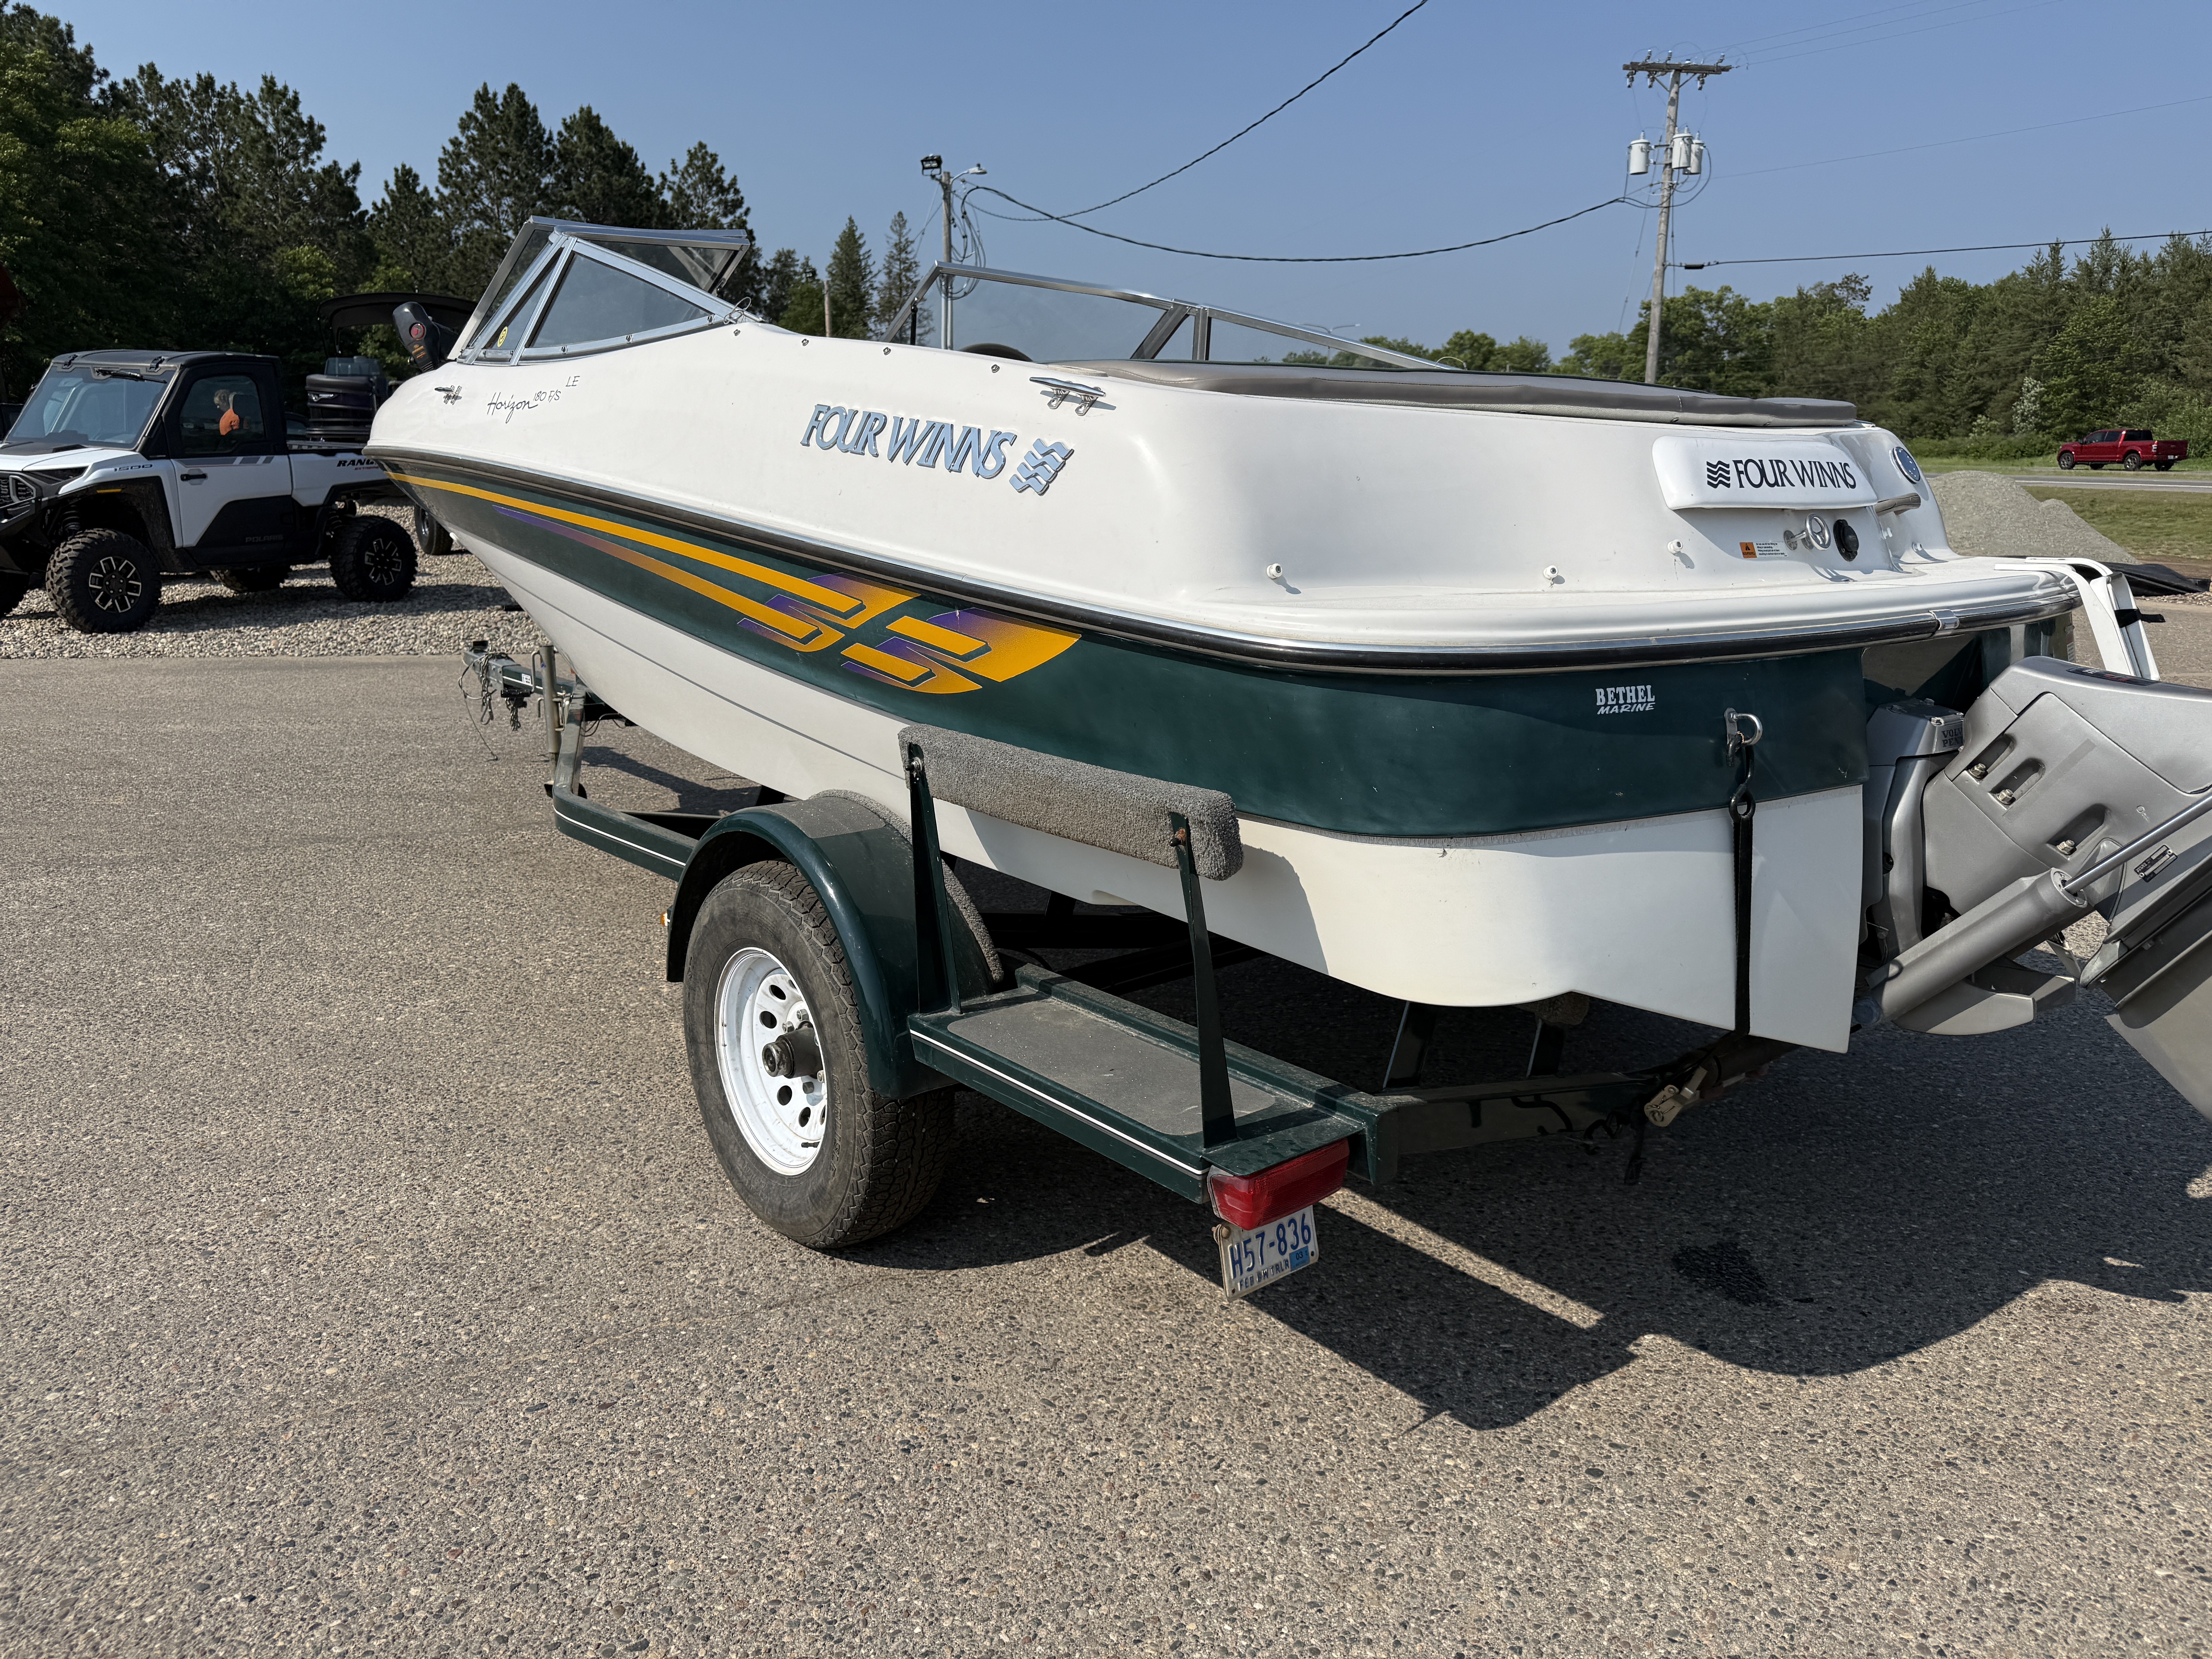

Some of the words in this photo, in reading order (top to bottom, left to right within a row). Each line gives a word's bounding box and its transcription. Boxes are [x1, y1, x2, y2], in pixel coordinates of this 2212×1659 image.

[565, 376, 580, 387] LE
[487, 392, 538, 424] Horizon
[533, 391, 547, 401] 180
[548, 390, 561, 403] F/S
[800, 404, 887, 457] FOUR
[887, 416, 1017, 479] WINNS
[1732, 459, 1795, 487] FOUR
[1789, 460, 1856, 489] WINNS
[1595, 685, 1655, 706] BETHEL
[1597, 702, 1656, 715] MARINE
[1229, 1214, 1311, 1279] H57-836
